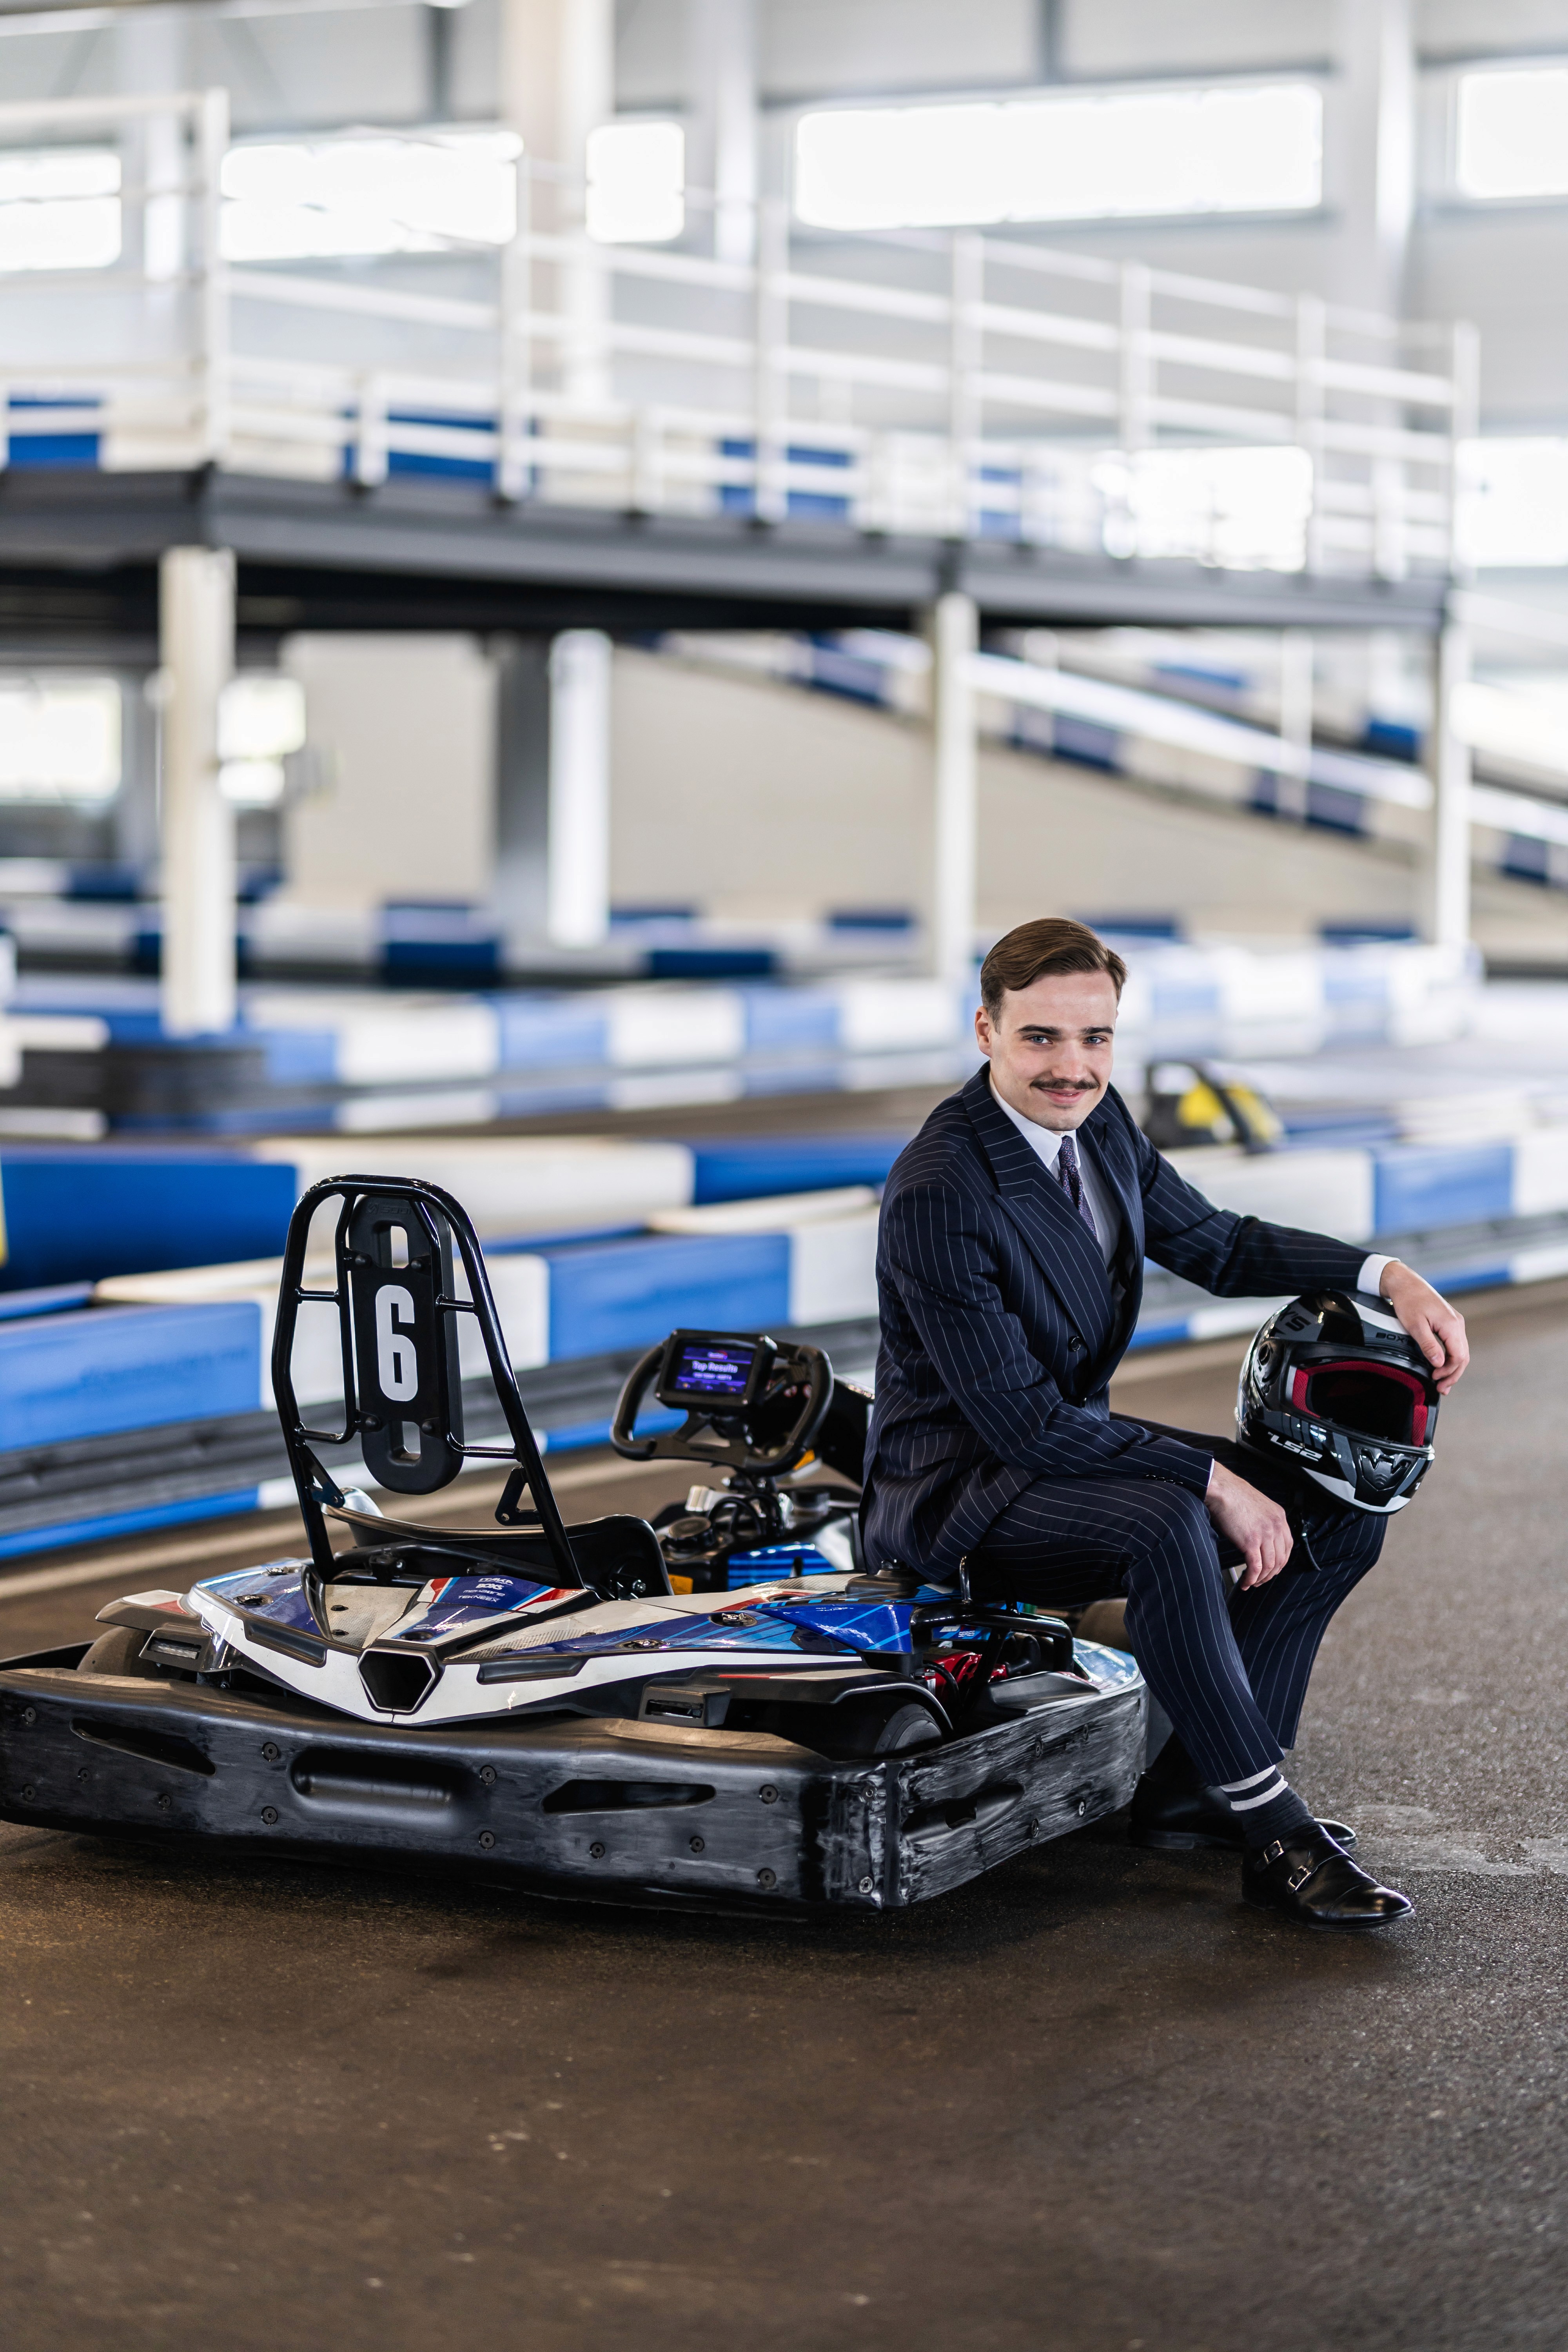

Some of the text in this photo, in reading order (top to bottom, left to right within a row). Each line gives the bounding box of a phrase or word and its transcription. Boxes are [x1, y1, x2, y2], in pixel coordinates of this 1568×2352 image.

[375, 1285, 418, 1401] 6
[693, 1361, 707, 1371] Top
[1270, 1434, 1323, 1461] LS2
